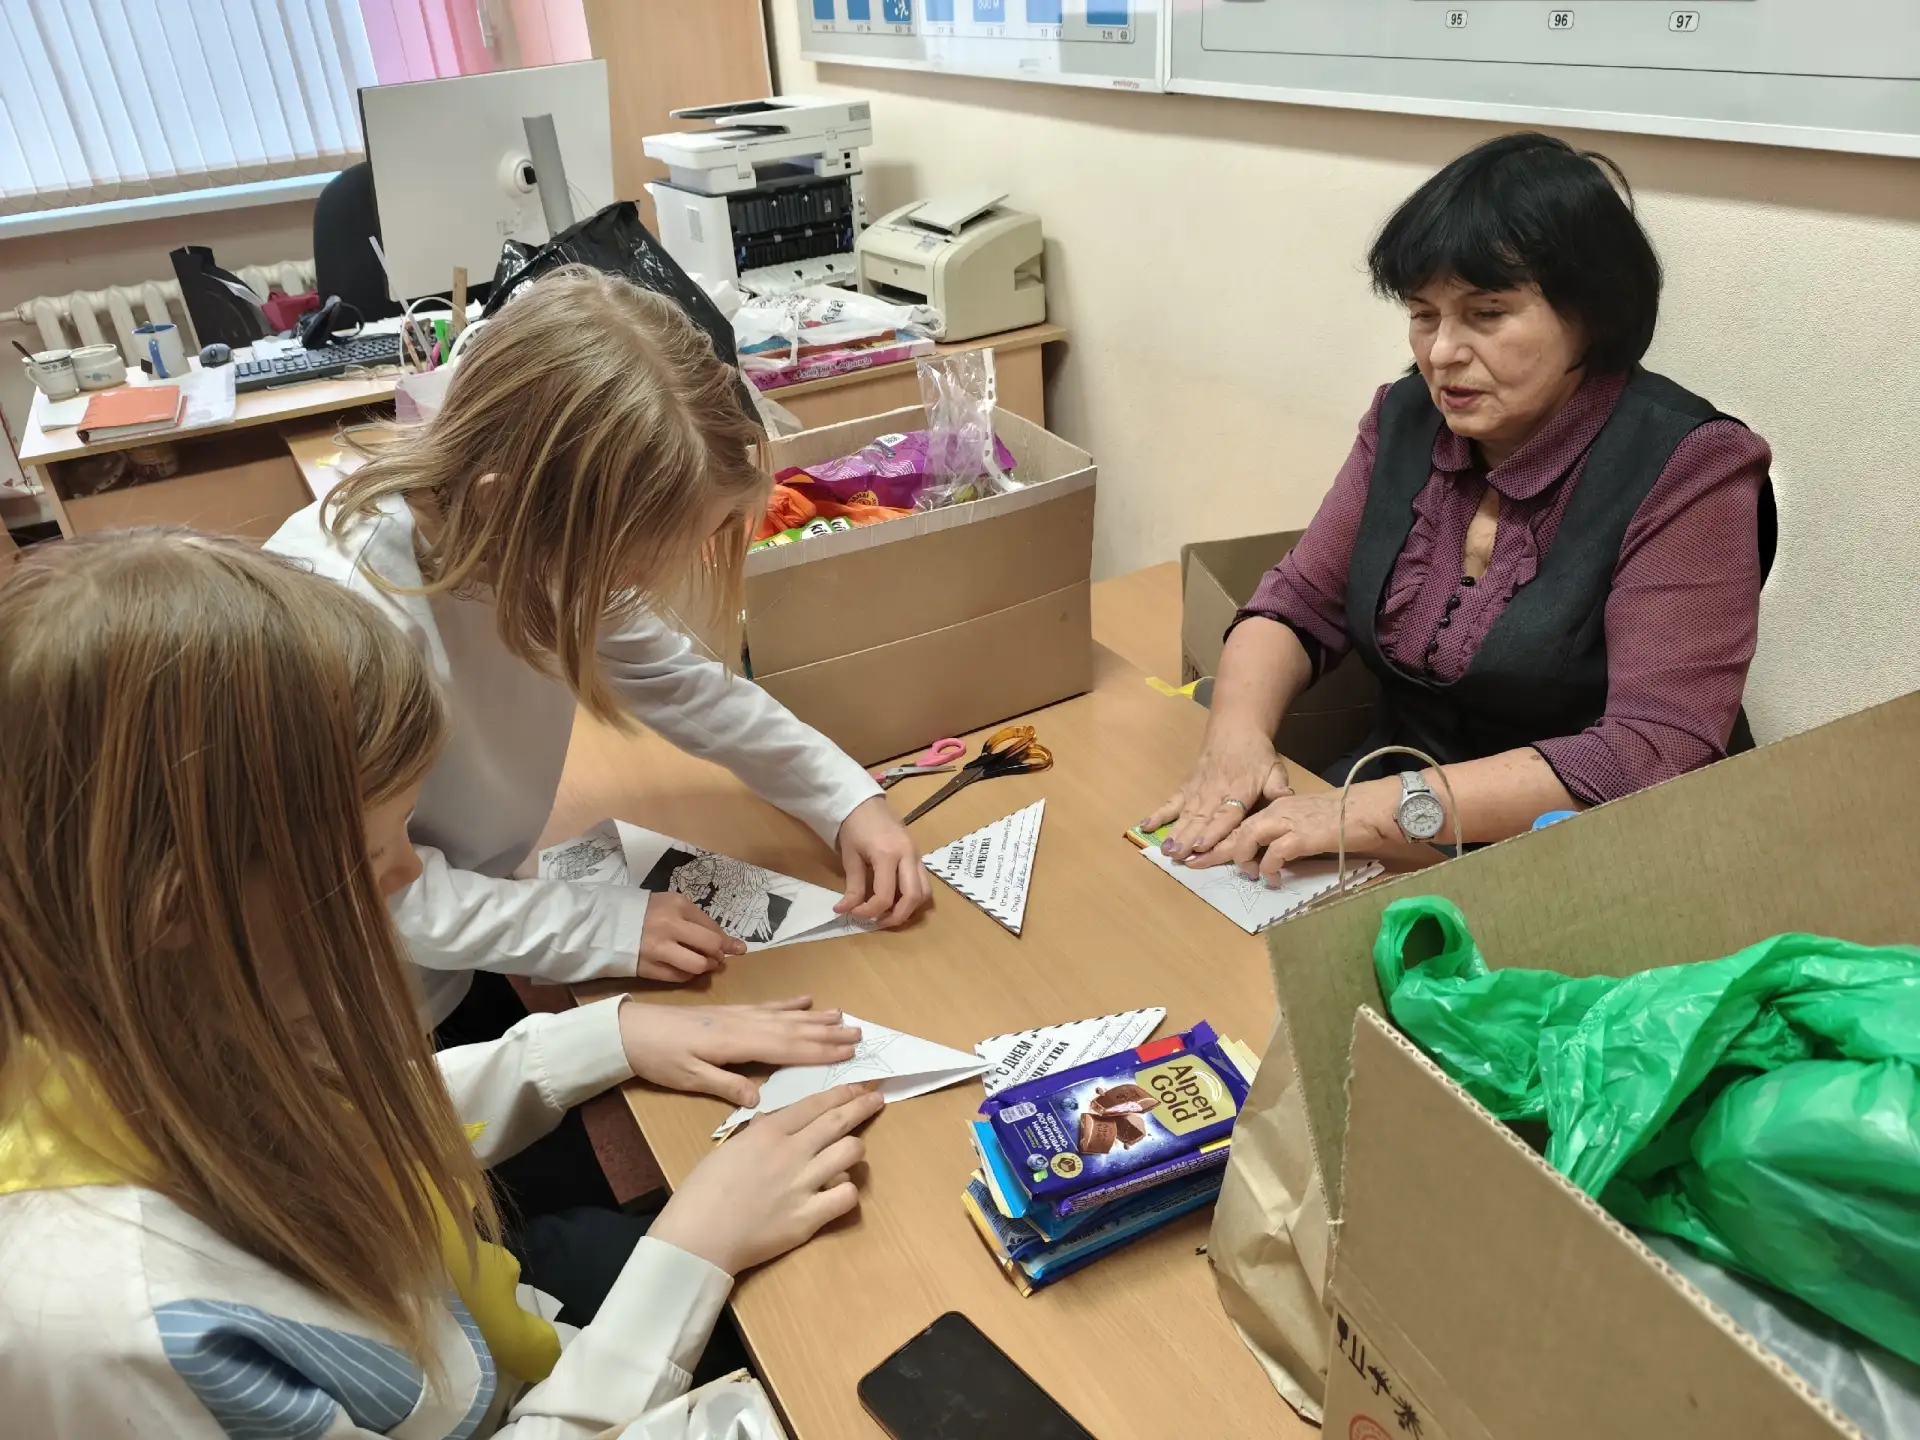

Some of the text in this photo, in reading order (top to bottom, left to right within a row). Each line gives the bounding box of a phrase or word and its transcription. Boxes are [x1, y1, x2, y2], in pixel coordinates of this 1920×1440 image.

[1450, 13, 1463, 25] 95
[1554, 14, 1568, 27] 96
[1676, 15, 1692, 28] 97
[951, 845, 965, 866] ДНЕМ
[974, 837, 992, 879] ОТЕЧЕСТВА
[996, 1040, 1033, 1076] С ДНЕМ
[1028, 1041, 1070, 1082] ЧЕСТВА
[1151, 1074, 1197, 1123] Gold
[1167, 1065, 1217, 1120] Alpen
[1036, 1112, 1062, 1152] ЙОГУРТОВАЯ
